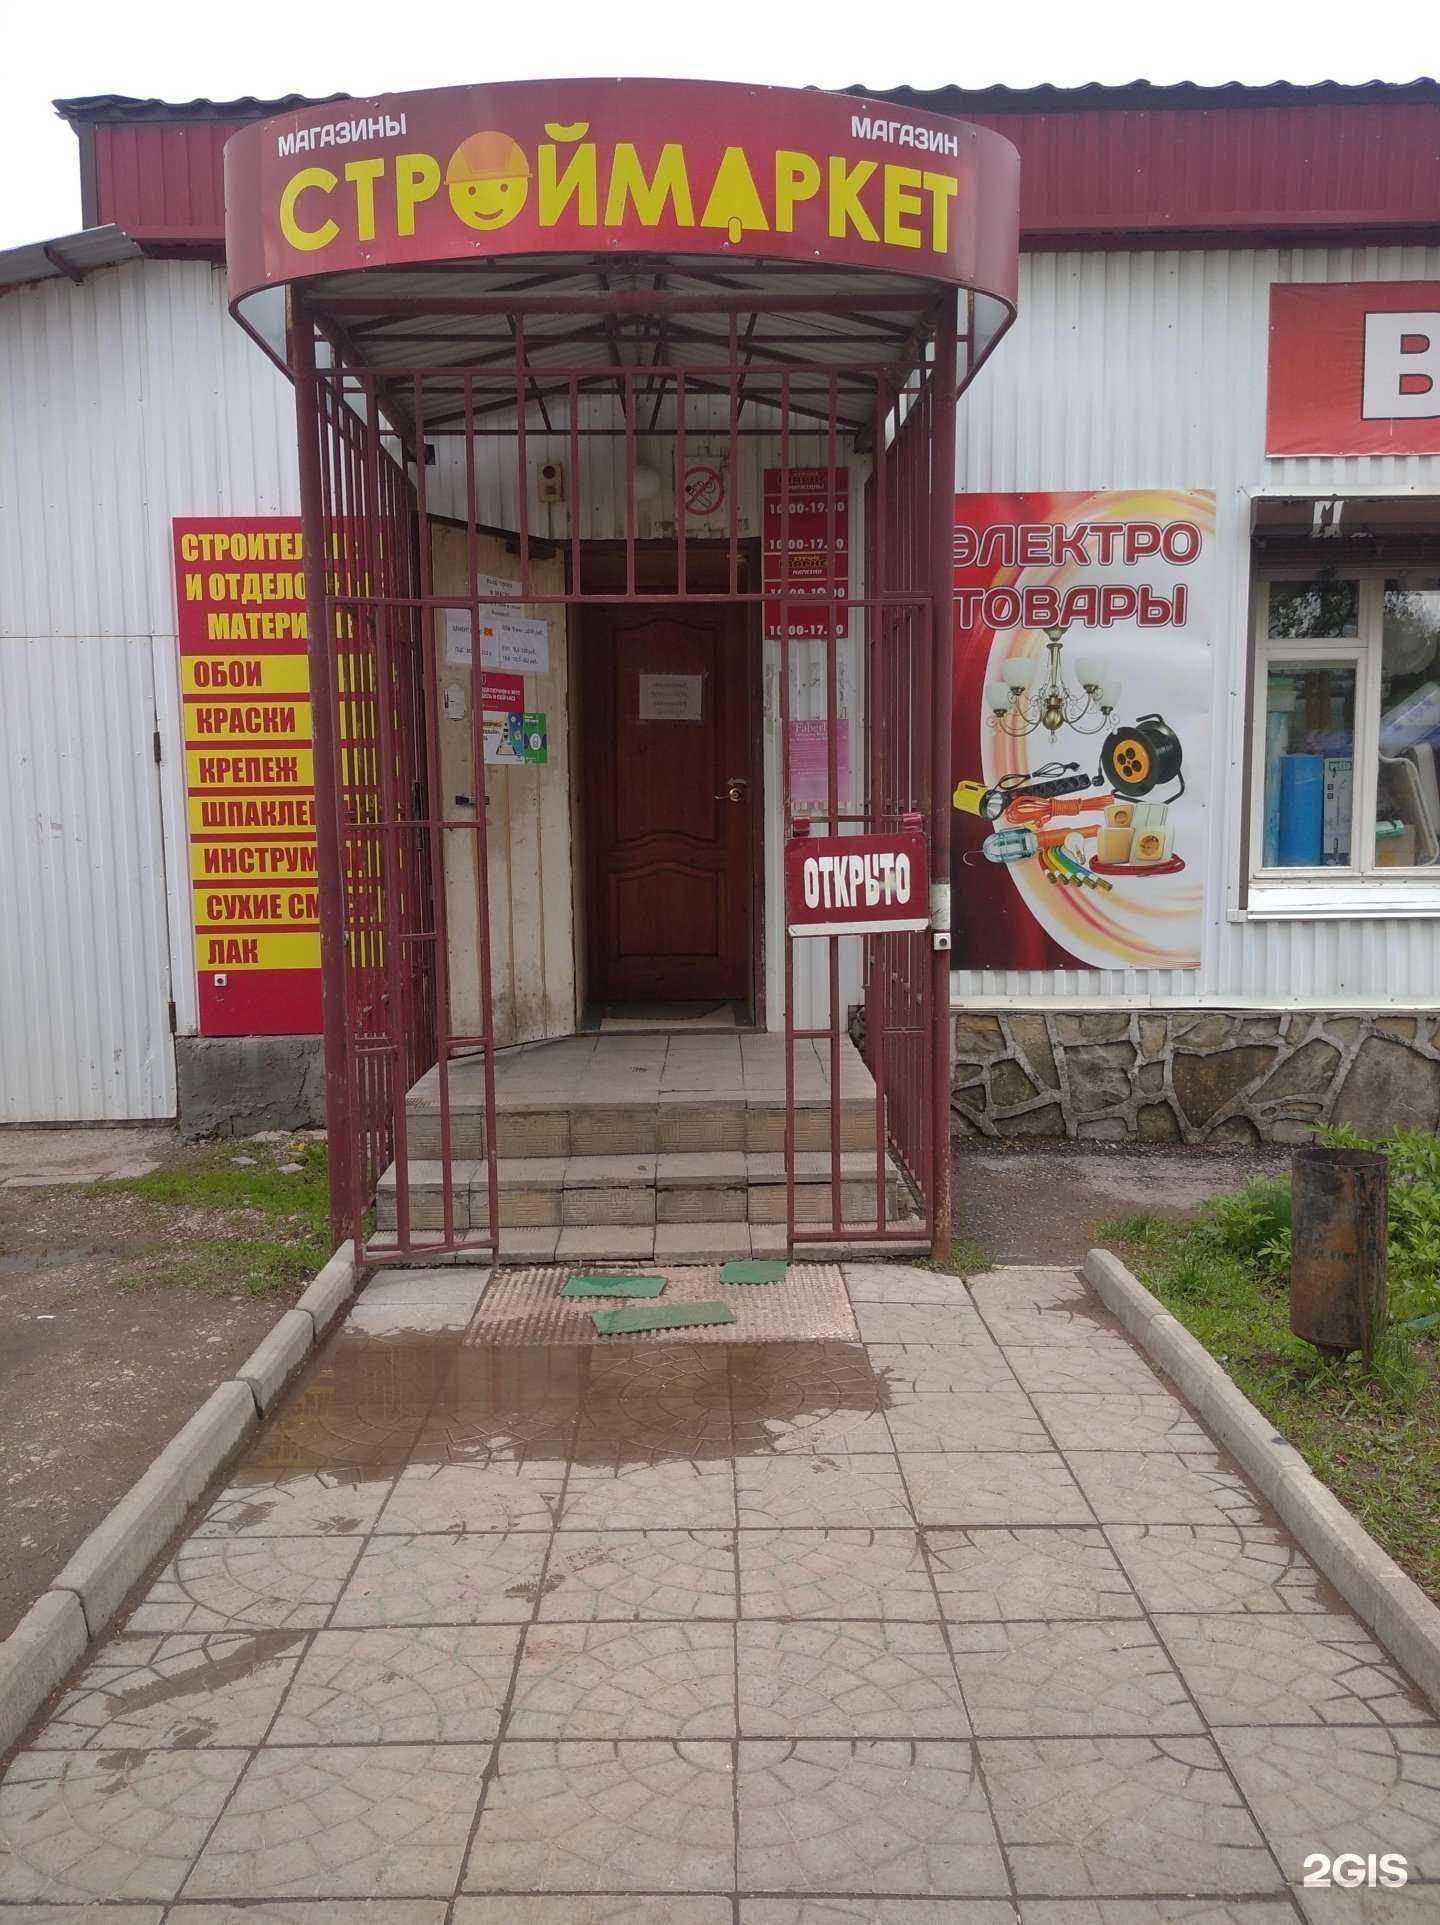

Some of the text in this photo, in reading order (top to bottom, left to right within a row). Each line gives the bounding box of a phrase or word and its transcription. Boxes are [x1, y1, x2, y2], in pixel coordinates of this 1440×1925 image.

[278, 112, 407, 157] МАГАЗИНЫ
[851, 115, 958, 157] МАГАЗИН
[279, 122, 958, 254] СТРОЙМАРКЕТ
[181, 533, 304, 562] СТРОИТЕЛ
[953, 521, 1202, 567] ЭЛЕКТРО
[185, 573, 306, 605] И ОТДЕЛО
[953, 584, 1188, 630] ТОВАРЫ
[207, 612, 309, 640] МАТЕРИ
[193, 660, 263, 688] ОБОИ
[196, 707, 296, 734] КРАСКИ
[199, 757, 298, 783] КРЕПЕЖ
[201, 800, 317, 827] ШПАКЛЕ
[204, 847, 318, 874] ИНСТРУМ
[803, 852, 911, 909] ОТКРЫТО
[206, 894, 282, 921] СУХИЕ
[208, 939, 259, 965] ЛАК
